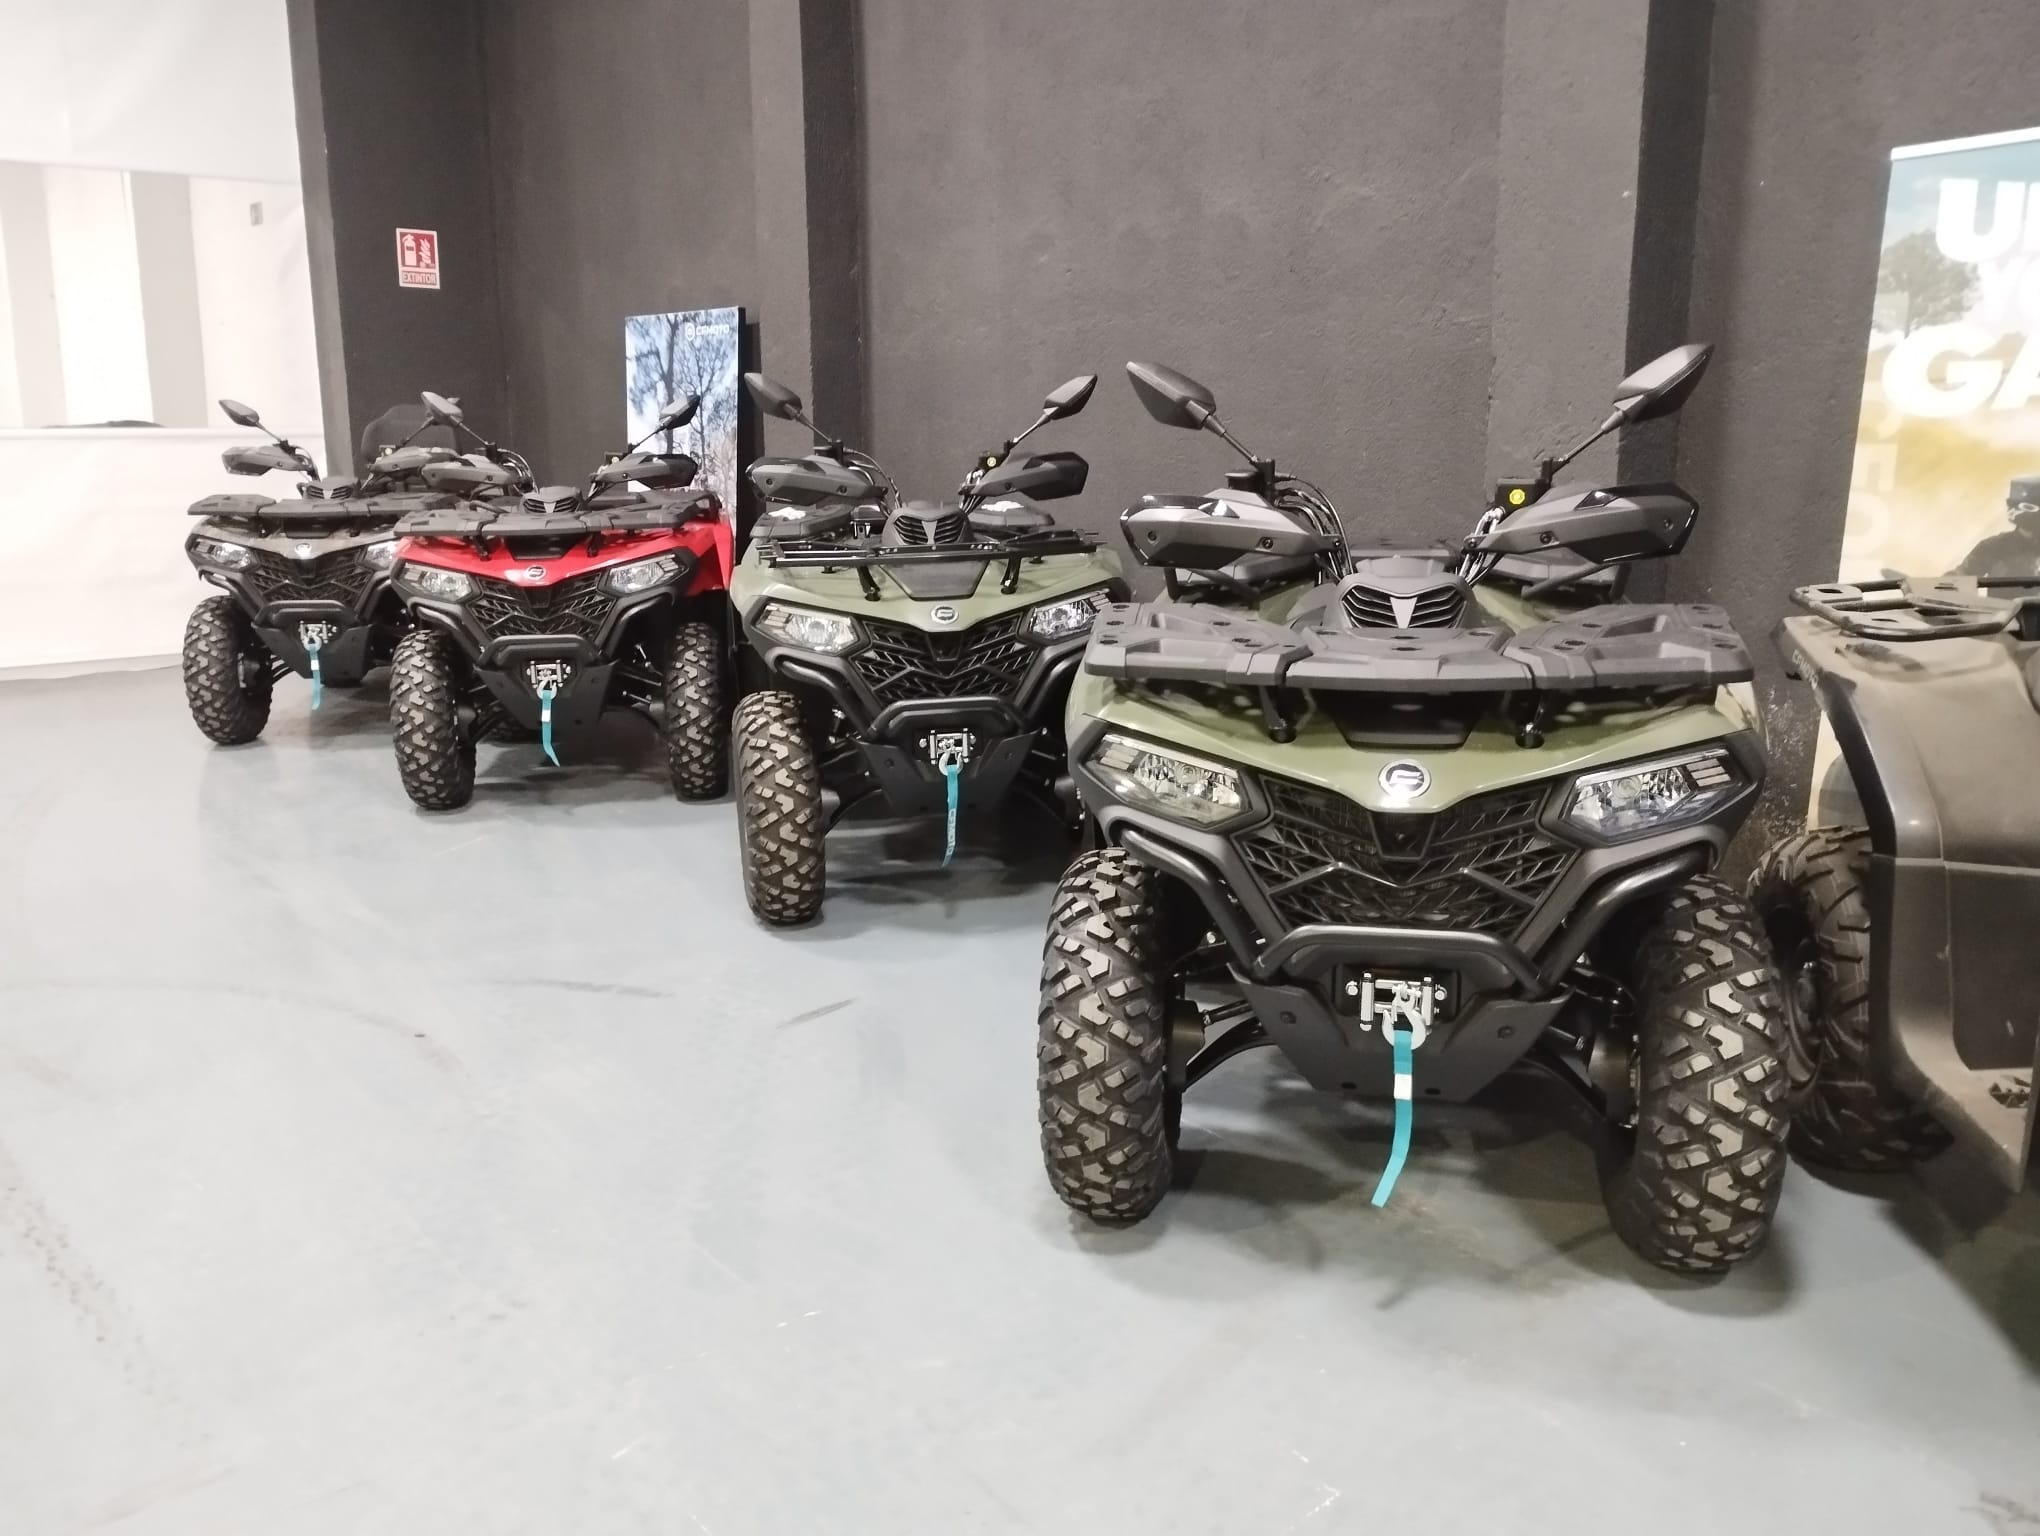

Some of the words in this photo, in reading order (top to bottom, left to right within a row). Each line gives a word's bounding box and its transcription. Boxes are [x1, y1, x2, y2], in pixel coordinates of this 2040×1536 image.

[1936, 178, 2040, 263] U
[402, 272, 436, 285] EXTINTOR
[696, 324, 730, 336] CFMOTO
